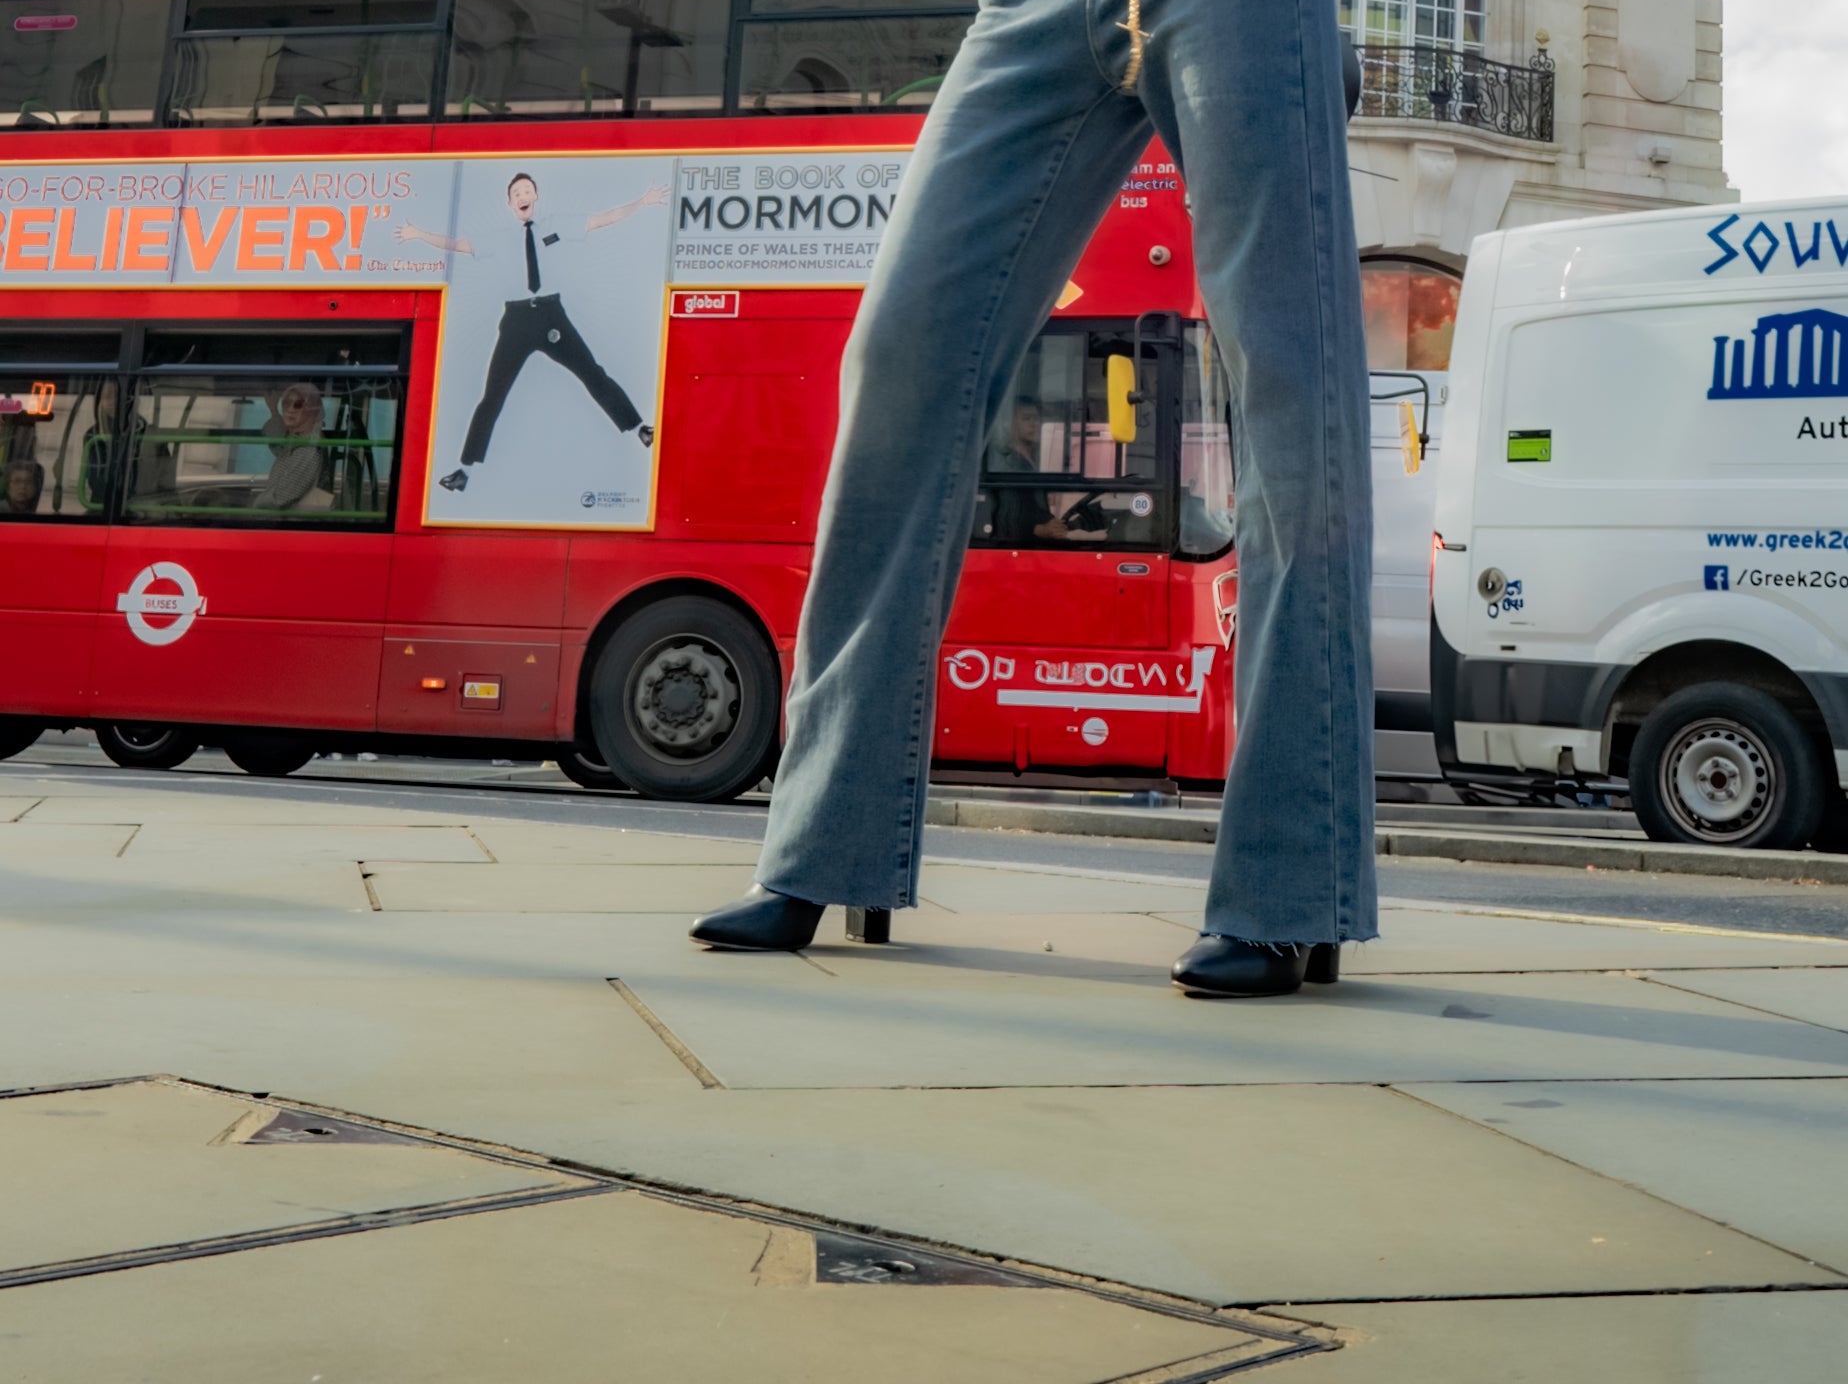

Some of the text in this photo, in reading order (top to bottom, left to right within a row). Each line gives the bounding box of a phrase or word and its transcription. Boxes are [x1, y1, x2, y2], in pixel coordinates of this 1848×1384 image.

[1156, 163, 1176, 174] an
[681, 164, 901, 190] THE BOOK OF
[1121, 178, 1177, 190] electric
[0, 171, 418, 203] O-FOR-BROKE HILARIOUS.
[1120, 194, 1148, 208] bus
[678, 194, 897, 230] MORMON
[0, 204, 391, 272] ELIEVER!”
[675, 243, 733, 256] PRINCE
[738, 243, 760, 255] OF
[763, 243, 818, 255] WALES
[366, 258, 446, 272] The Telegraph
[684, 294, 726, 313] global
[1797, 415, 1848, 439] Aut
[1134, 499, 1148, 510] 80
[144, 599, 178, 610] BUSES
